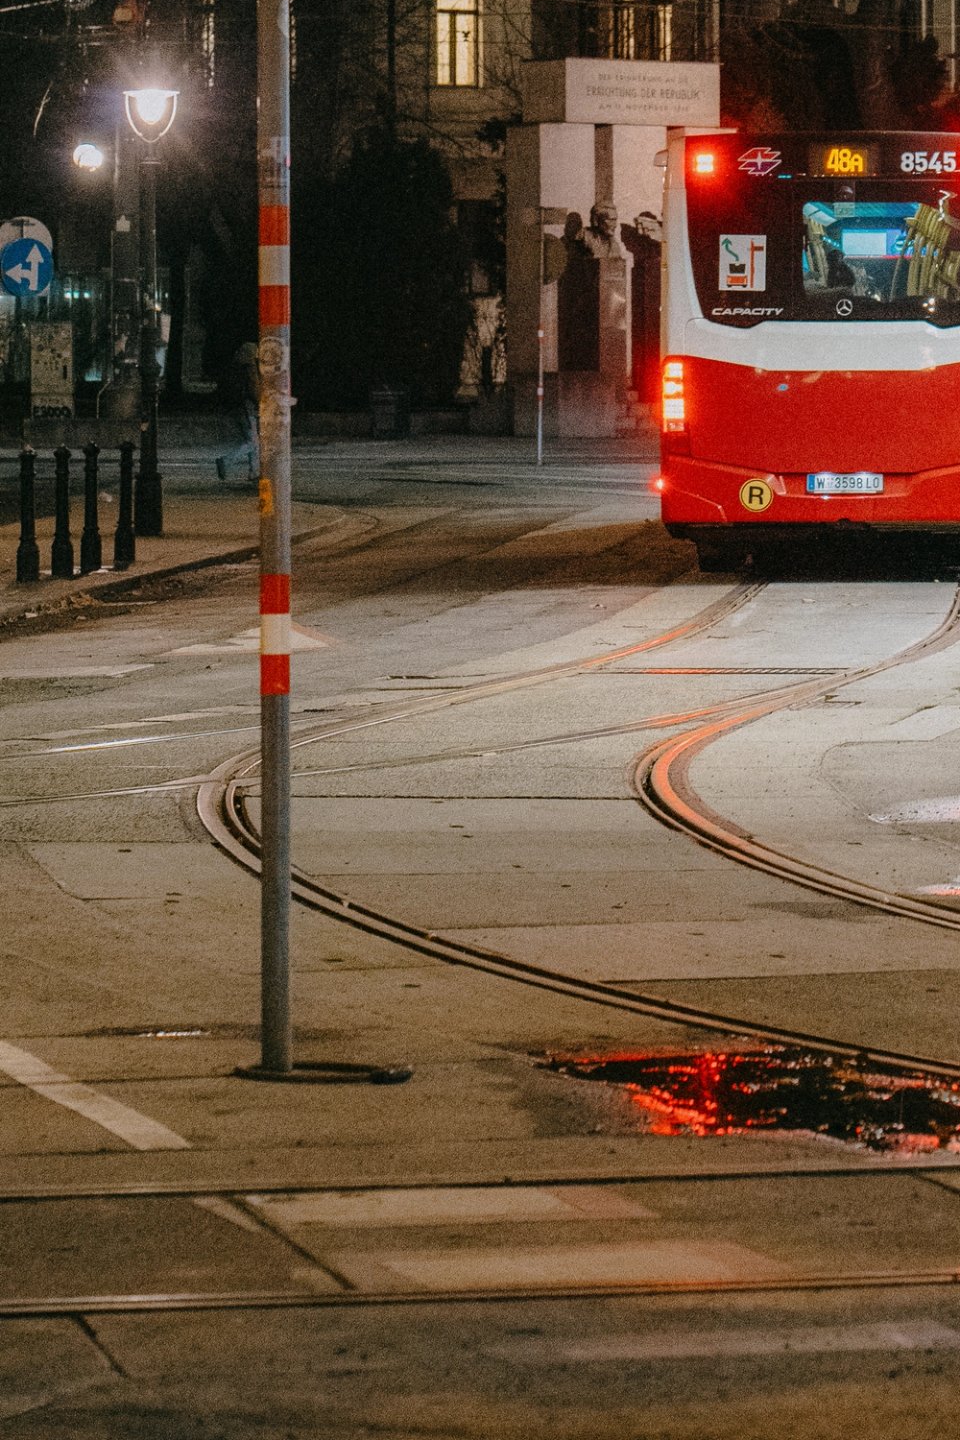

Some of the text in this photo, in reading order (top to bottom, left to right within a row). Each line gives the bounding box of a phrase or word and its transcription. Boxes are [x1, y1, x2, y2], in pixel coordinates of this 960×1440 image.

[826, 148, 863, 173] 48A
[900, 151, 957, 173] 8545
[711, 307, 784, 316] CAPACITY
[817, 477, 825, 489] W
[835, 477, 863, 489] 3598
[748, 486, 764, 505] R
